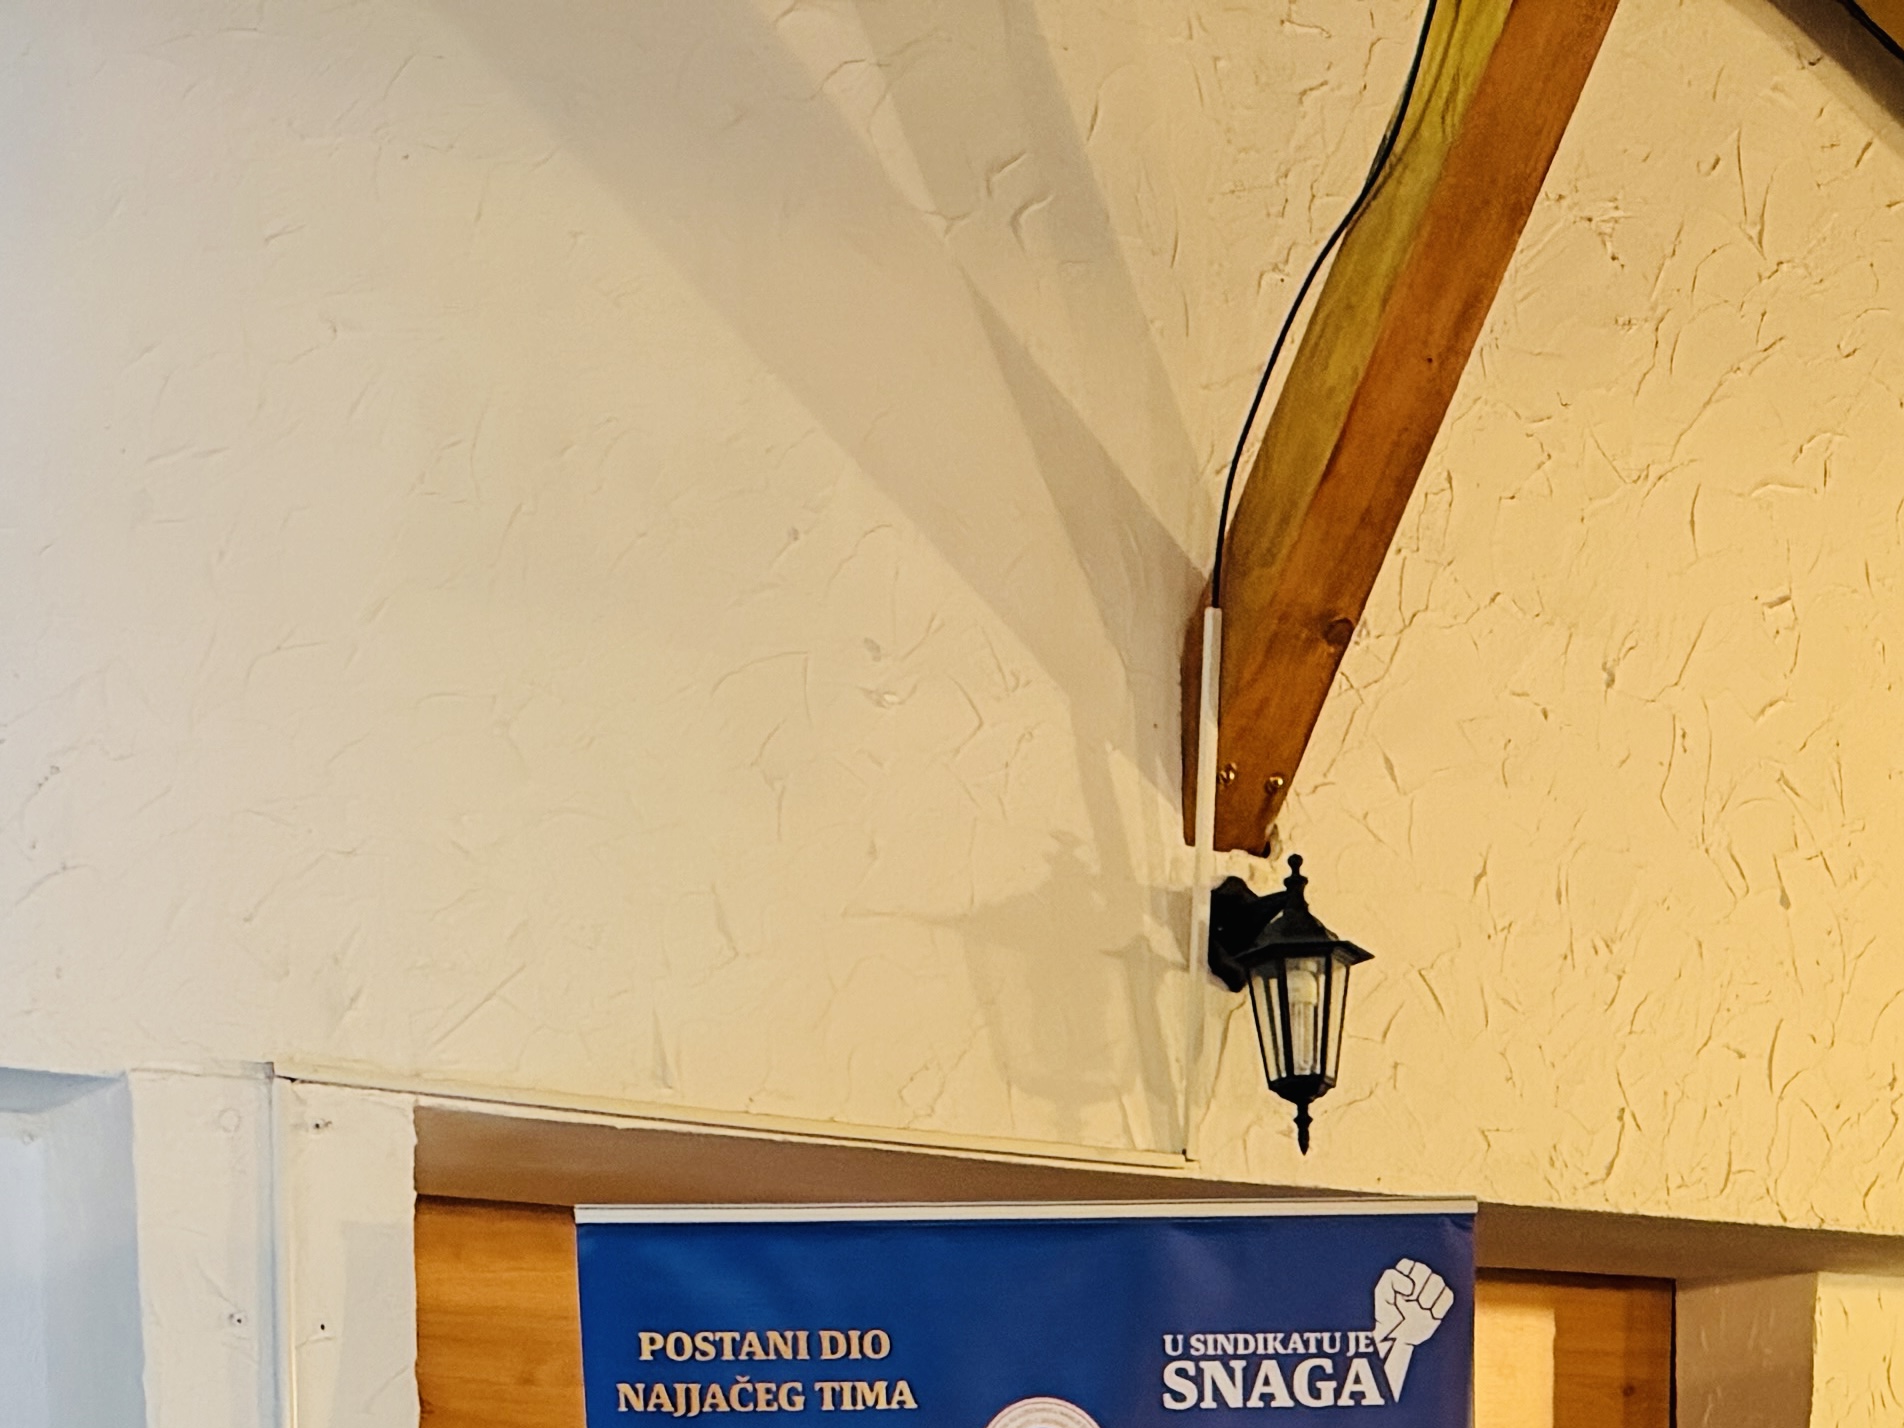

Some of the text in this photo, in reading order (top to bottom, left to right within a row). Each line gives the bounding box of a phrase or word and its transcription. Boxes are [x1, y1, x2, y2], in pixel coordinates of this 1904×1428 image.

[638, 1328, 893, 1363] POSTANI DIO
[1162, 1330, 1377, 1359] U SINDIKATU JE
[616, 1369, 918, 1419] NAJJAČEG TIMA
[1161, 1358, 1387, 1411] SNAGA
